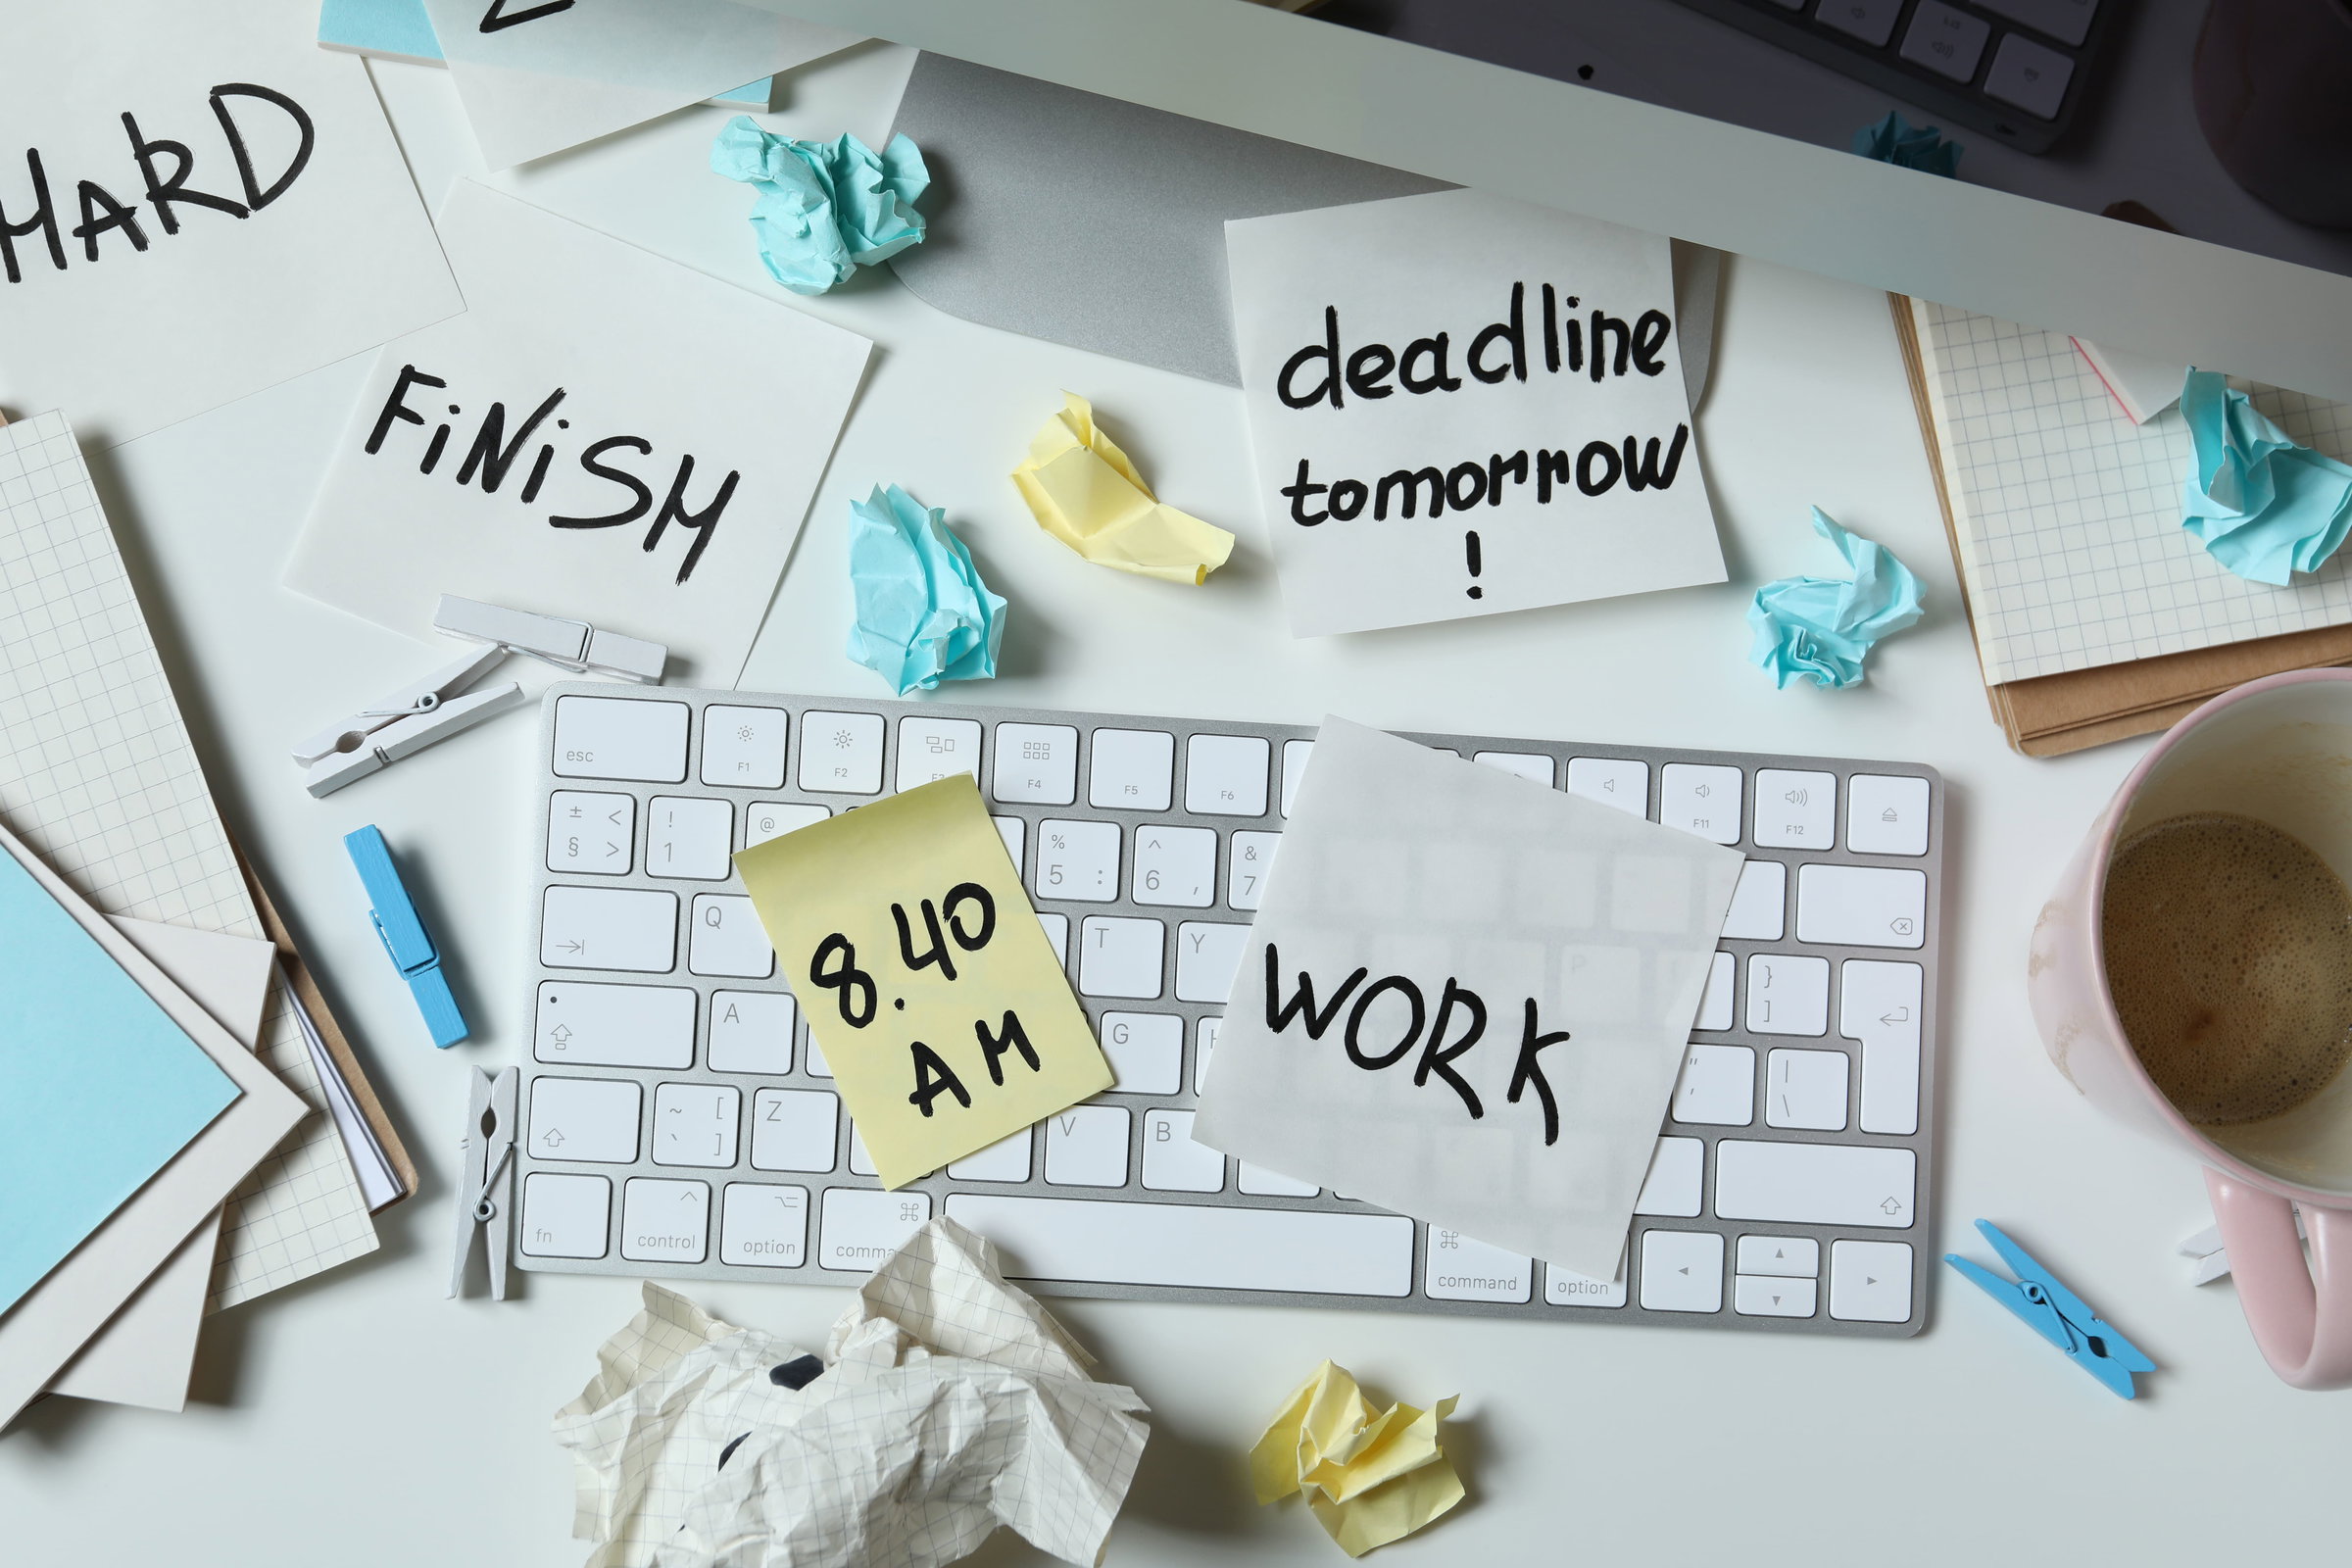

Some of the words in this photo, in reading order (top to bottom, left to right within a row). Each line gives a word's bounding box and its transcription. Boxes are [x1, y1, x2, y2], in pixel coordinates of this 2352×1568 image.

[0, 82, 315, 284] HARD
[1277, 280, 1672, 410] deadline
[1280, 422, 1690, 527] tomorrow
[565, 750, 594, 762] esc
[737, 761, 750, 772] F1
[834, 767, 849, 778] F2
[1027, 778, 1042, 790] F4
[1124, 784, 1139, 796] F5
[1220, 790, 1235, 801] F6
[760, 816, 775, 833] @
[1692, 818, 1710, 829] F11
[1786, 824, 1804, 836] F12
[663, 841, 672, 863] 1
[1051, 834, 1065, 850] %
[1244, 845, 1257, 861] &
[1049, 863, 1063, 886] 5
[1145, 869, 1160, 891] 6
[1243, 875, 1257, 897] 7
[705, 906, 722, 930] Q
[1094, 927, 1110, 949] T
[1190, 932, 1206, 955] Y
[809, 882, 996, 1029] 8.40
[722, 1003, 740, 1024] A
[1112, 1022, 1129, 1045] G
[1265, 942, 1571, 1147] WORK
[909, 1010, 1041, 1117] AM
[765, 1100, 783, 1122] Z
[1058, 1115, 1077, 1138] V
[1155, 1120, 1172, 1143] B
[535, 1228, 553, 1244] fn
[637, 1234, 696, 1250] control
[743, 1239, 796, 1256] option
[836, 1246, 895, 1258] comm
[1438, 1276, 1518, 1291] command
[1557, 1279, 1609, 1297] option
